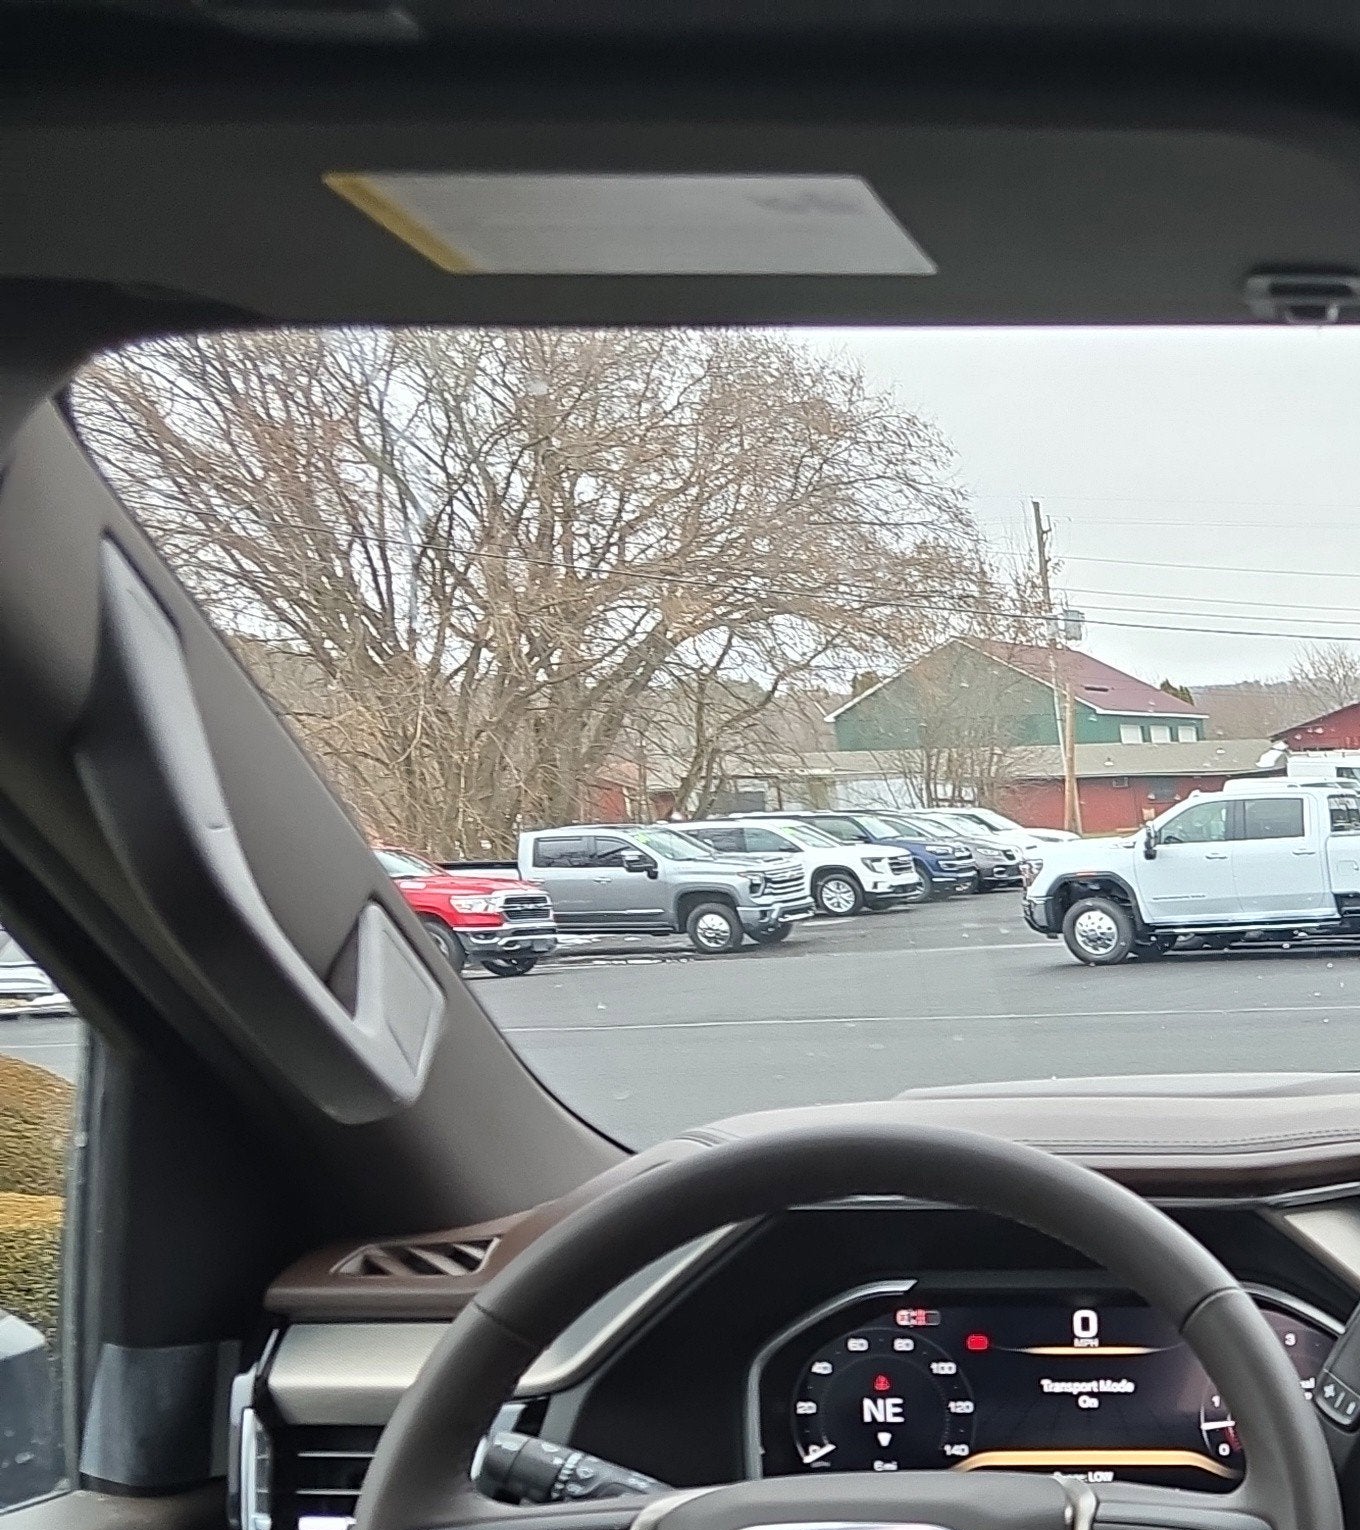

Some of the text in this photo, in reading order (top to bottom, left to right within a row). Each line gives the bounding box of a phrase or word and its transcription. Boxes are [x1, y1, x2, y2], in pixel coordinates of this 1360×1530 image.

[1072, 1309, 1098, 1338] 0
[847, 1338, 869, 1352] 60
[893, 1338, 915, 1352] 80
[1073, 1338, 1099, 1348] MPH
[1284, 1332, 1296, 1346] 3
[811, 1362, 833, 1375] 40
[930, 1361, 957, 1375] 100
[1040, 1378, 1135, 1394] Transport Mode
[796, 1401, 817, 1415] 20
[948, 1401, 974, 1414] 120
[1077, 1395, 1099, 1408] On
[862, 1397, 905, 1423] NE
[943, 1444, 969, 1457] 140
[1218, 1443, 1230, 1456] 0
[1088, 1471, 1114, 1482] LOW
